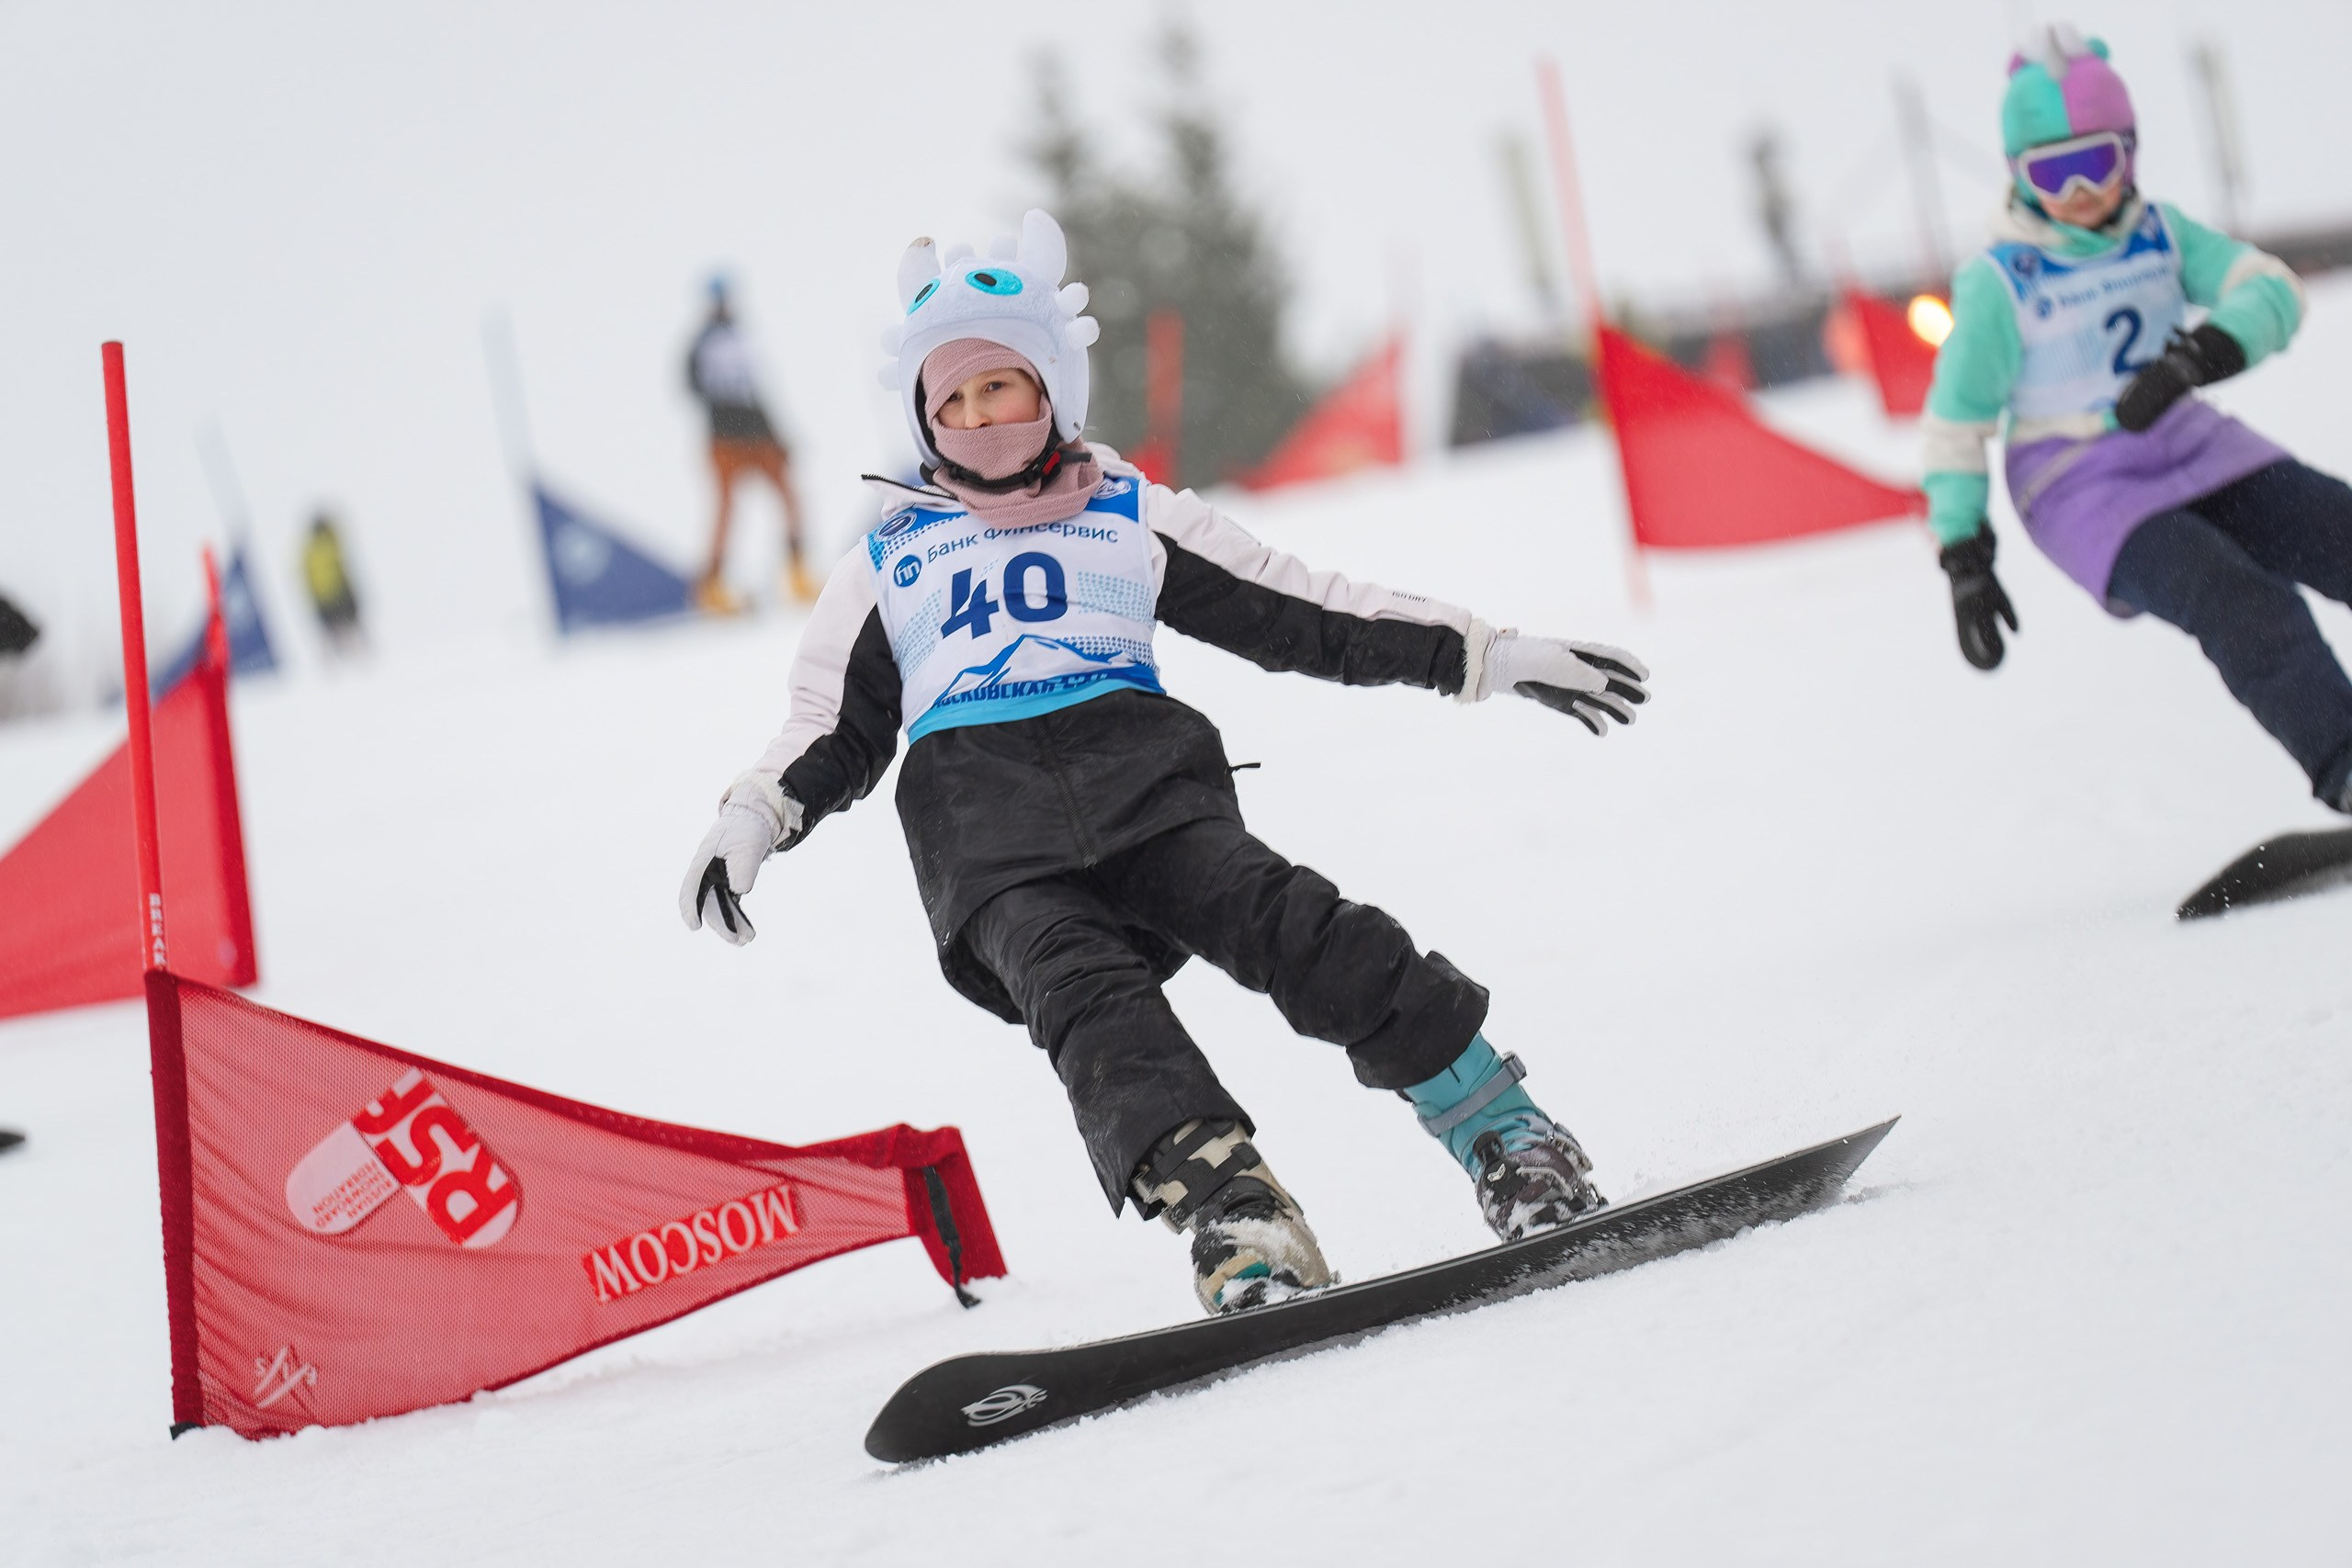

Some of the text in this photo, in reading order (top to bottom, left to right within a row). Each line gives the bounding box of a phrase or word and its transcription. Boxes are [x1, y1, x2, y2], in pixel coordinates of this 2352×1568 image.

[2105, 308, 2146, 374] 2
[927, 534, 978, 564] Банк
[940, 551, 1068, 639] 40
[353, 1077, 516, 1246] RSF
[592, 1185, 798, 1302] MOSCOW
